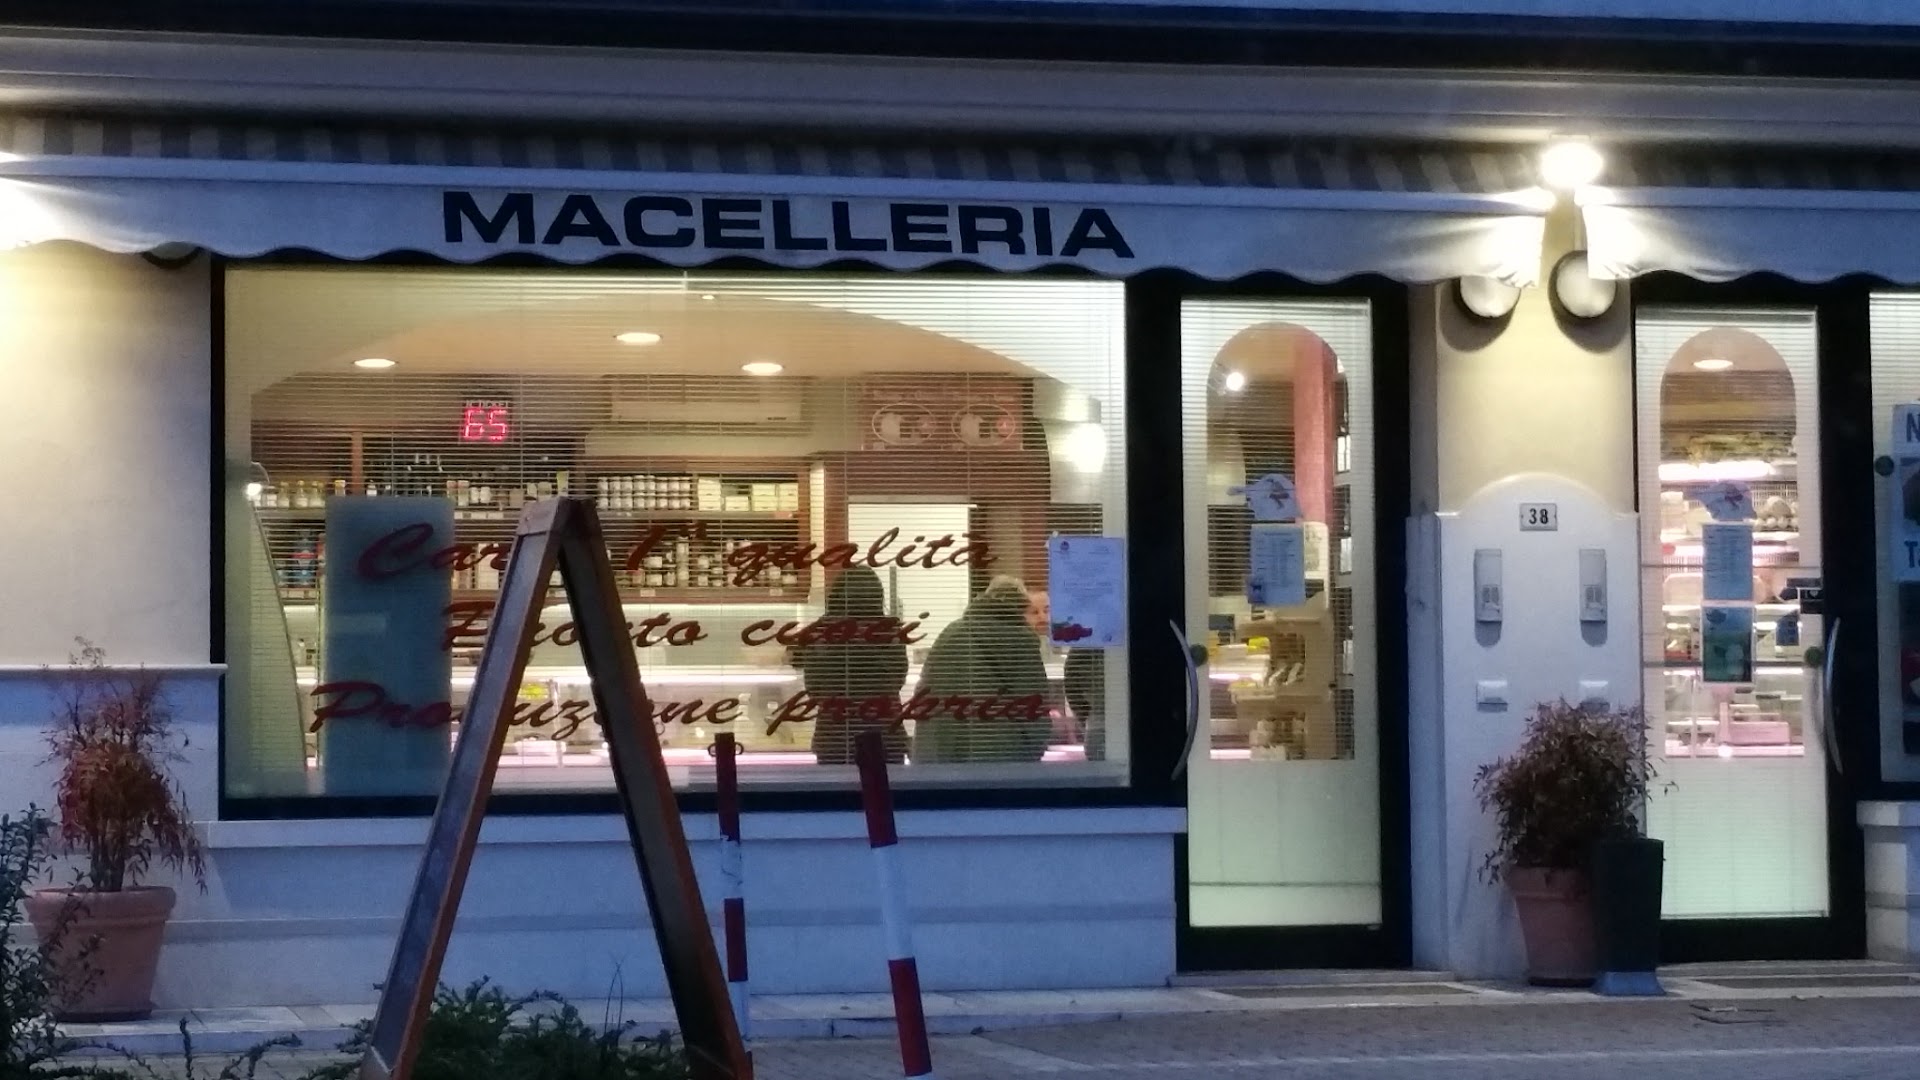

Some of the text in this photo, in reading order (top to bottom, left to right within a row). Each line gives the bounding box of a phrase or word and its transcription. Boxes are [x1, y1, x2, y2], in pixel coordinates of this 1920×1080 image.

[443, 191, 1135, 258] MACELLERIA
[464, 409, 508, 441] 65
[1529, 508, 1549, 525] 38
[727, 526, 998, 586] qualità
[765, 687, 1054, 736] propria
